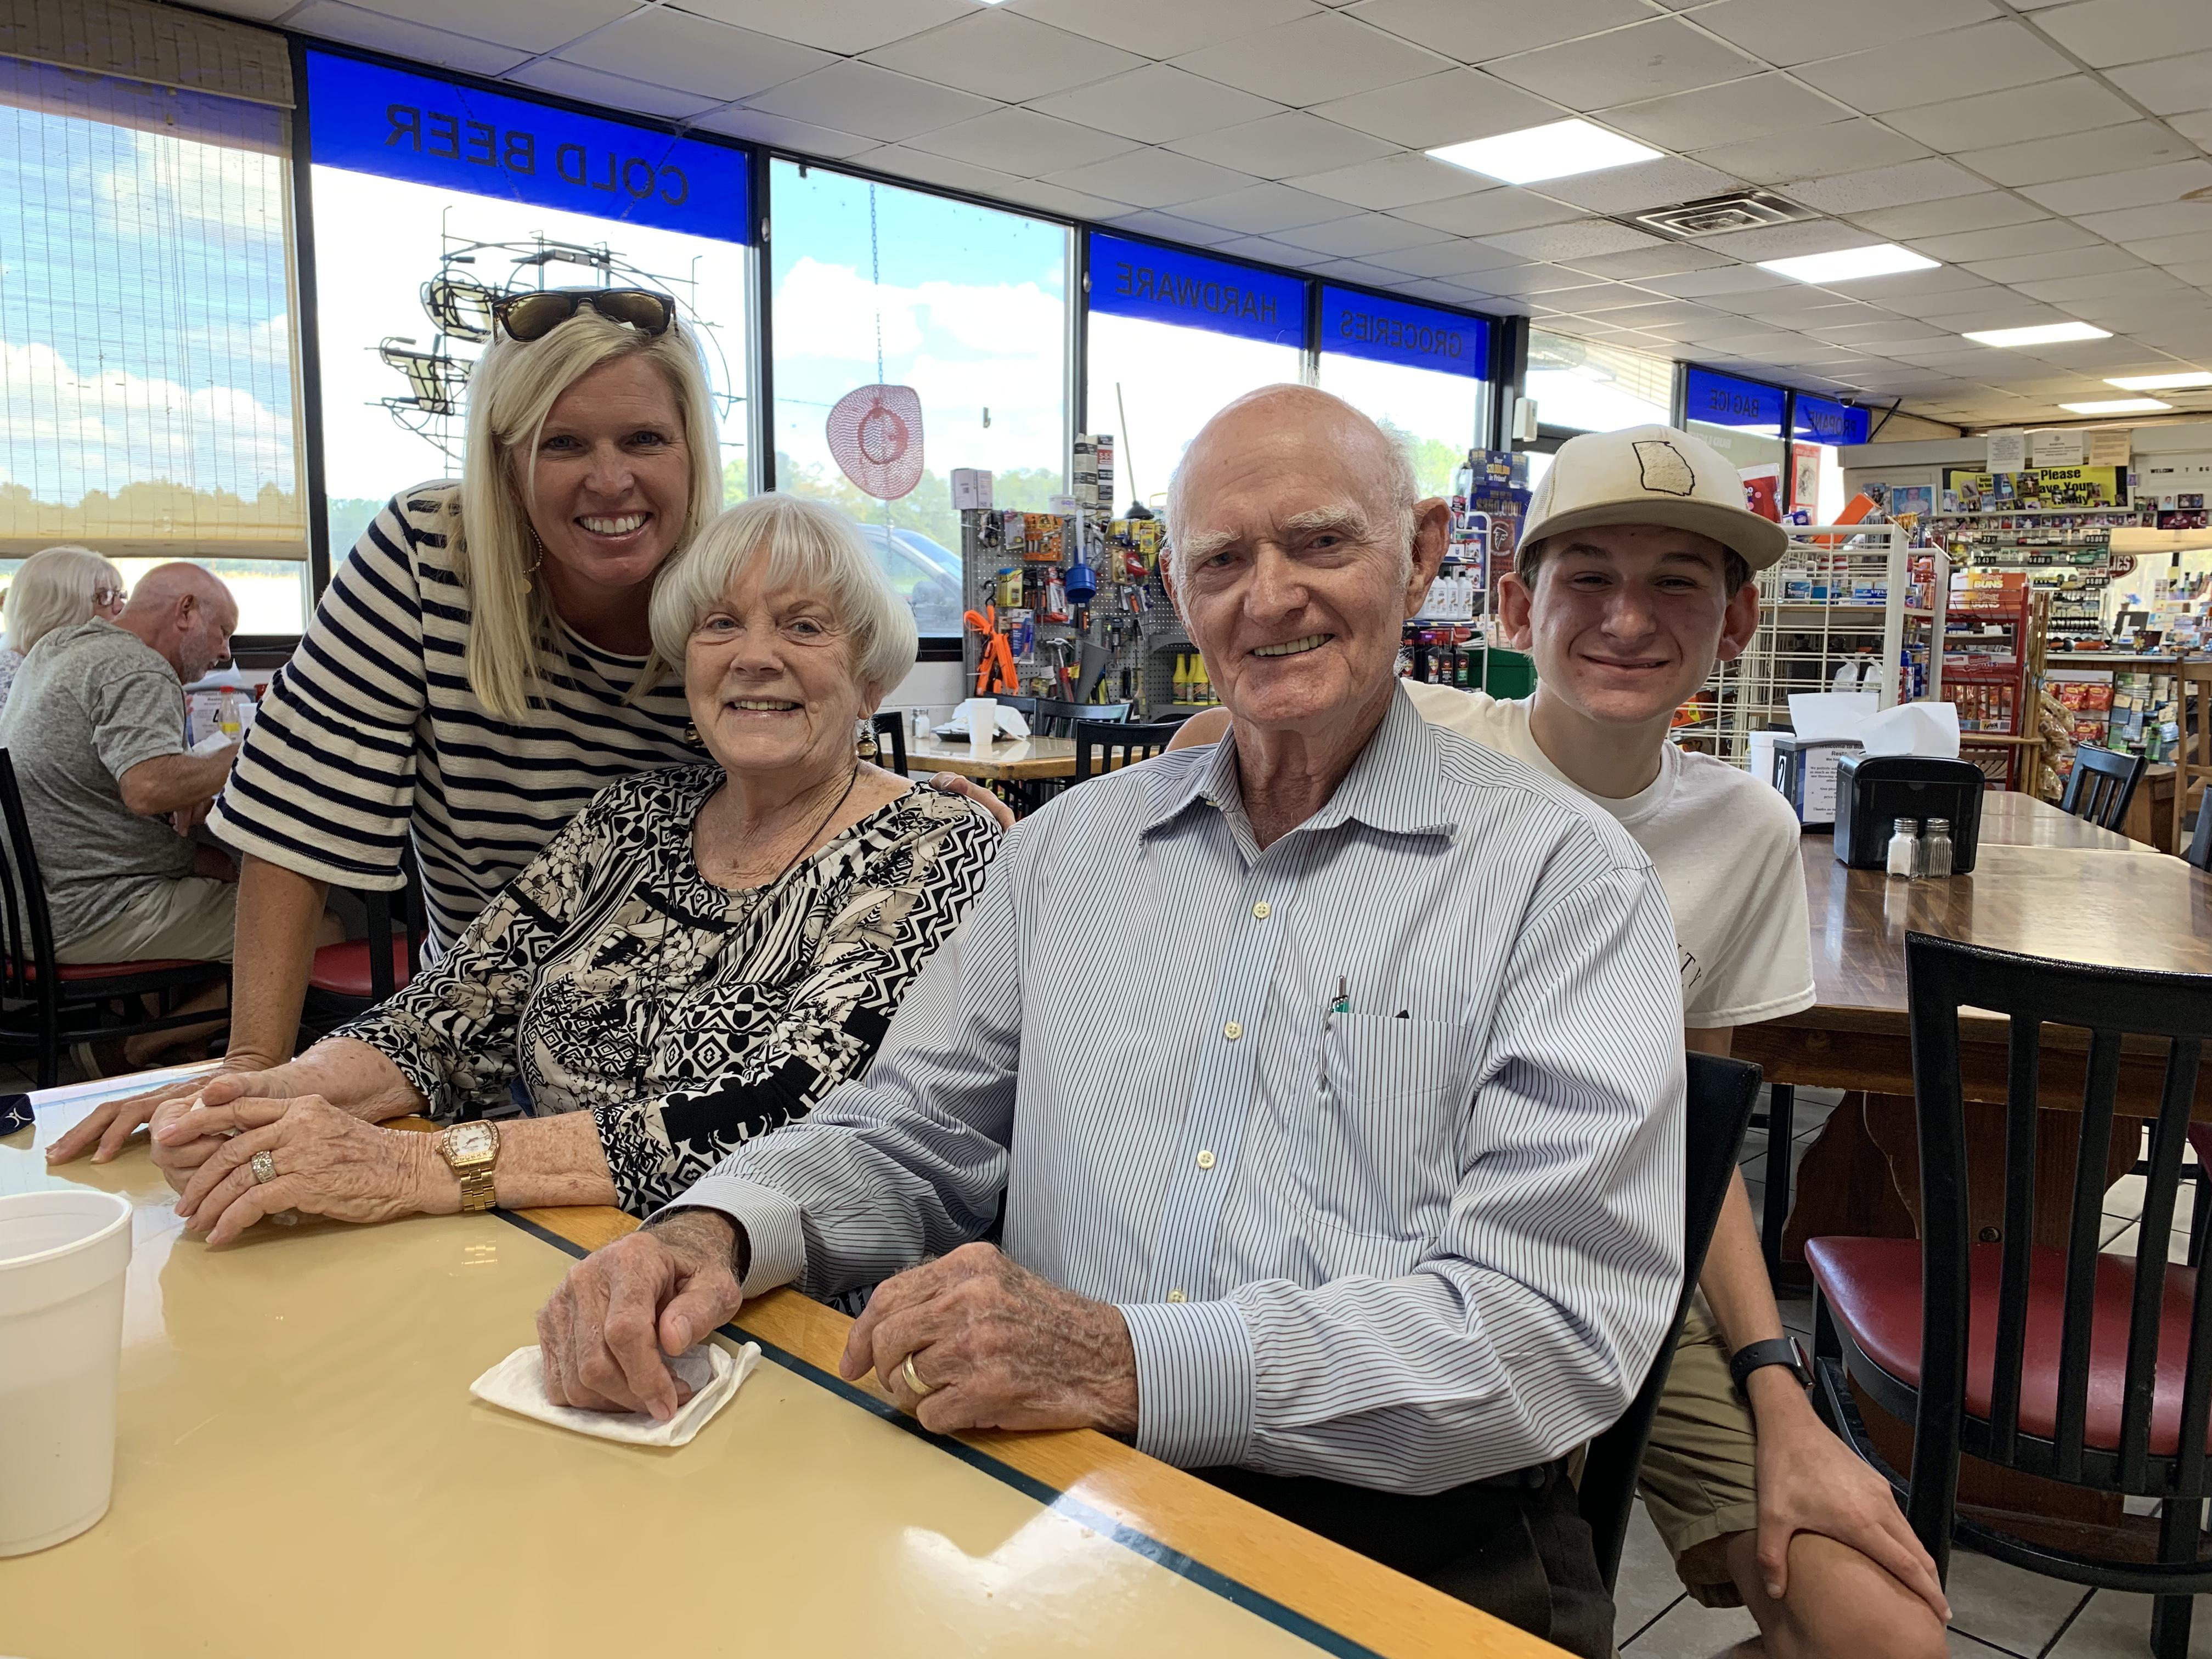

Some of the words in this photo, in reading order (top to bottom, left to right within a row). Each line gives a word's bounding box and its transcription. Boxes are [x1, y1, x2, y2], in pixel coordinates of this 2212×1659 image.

[2041, 469, 2081, 481] Please
[2039, 484, 2060, 493] ave
[1973, 579, 2004, 589] BUNS
